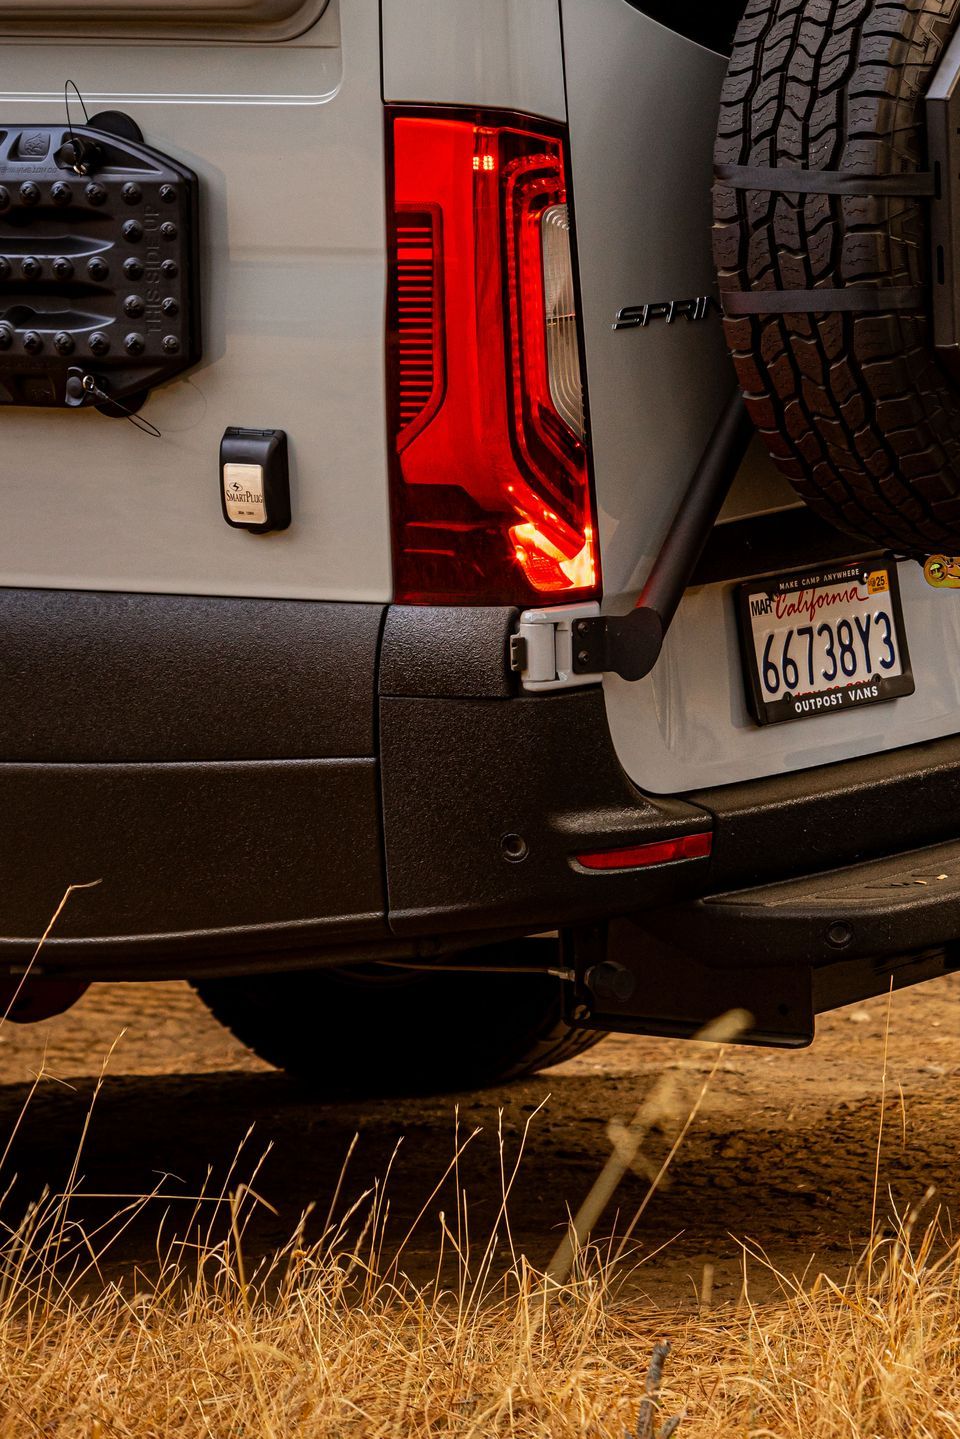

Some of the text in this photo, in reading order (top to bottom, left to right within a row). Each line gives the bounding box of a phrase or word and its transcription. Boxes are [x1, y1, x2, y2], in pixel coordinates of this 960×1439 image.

[143, 205, 162, 337] THIS SIDE UP
[779, 568, 860, 590] MAKE CAMP ANYWHERE
[751, 598, 773, 617] MAR
[775, 587, 869, 621] California
[762, 611, 896, 694] 66738Y3
[794, 693, 843, 713] OUTPOST
[848, 685, 879, 702] VANS
